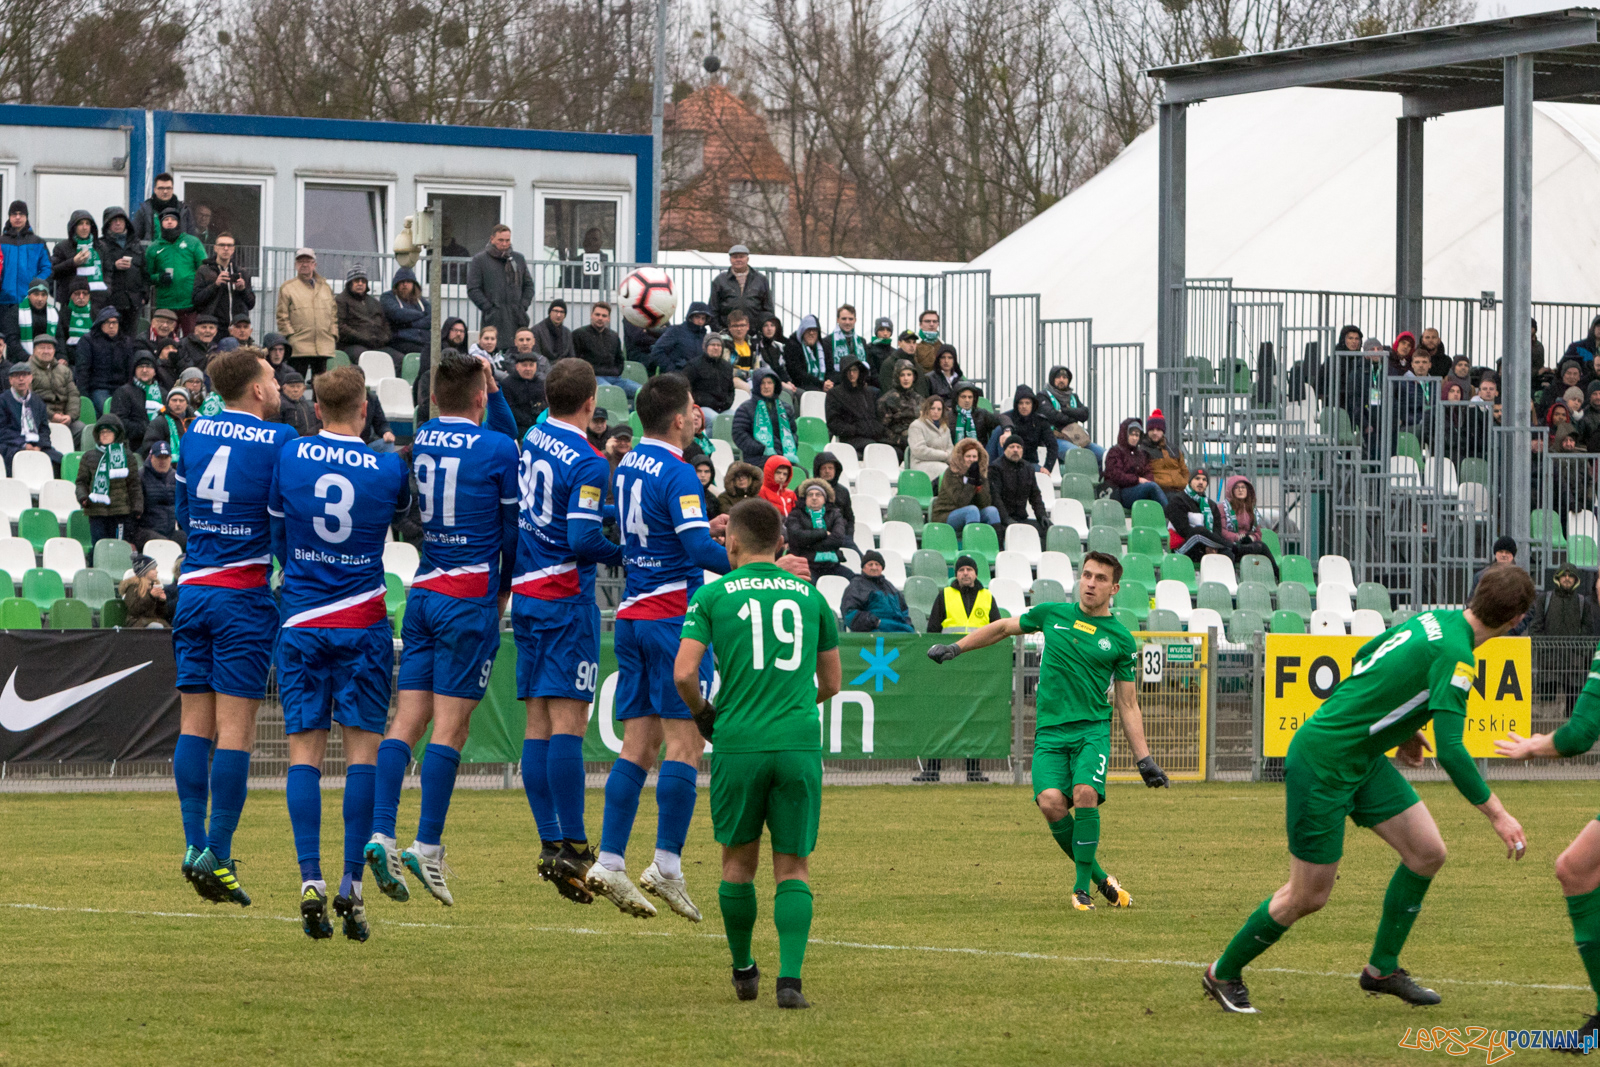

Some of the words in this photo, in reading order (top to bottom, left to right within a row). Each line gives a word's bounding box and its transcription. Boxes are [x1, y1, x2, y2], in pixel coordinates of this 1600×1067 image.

[585, 261, 599, 272] 30
[1482, 297, 1495, 308] 29
[193, 419, 277, 444] WIKTORSKI
[414, 429, 481, 449] OLEKSY
[297, 442, 379, 470] KOMOR
[196, 445, 231, 514] 4
[413, 453, 461, 527] 91
[312, 473, 355, 544] 3
[616, 474, 649, 548] 14
[724, 576, 809, 598] BIEGAŃSKI
[737, 597, 803, 671] 19
[575, 660, 598, 692] 90
[1145, 651, 1161, 675] 33
[1275, 655, 1524, 701] FONA
[1095, 753, 1107, 776] 3
